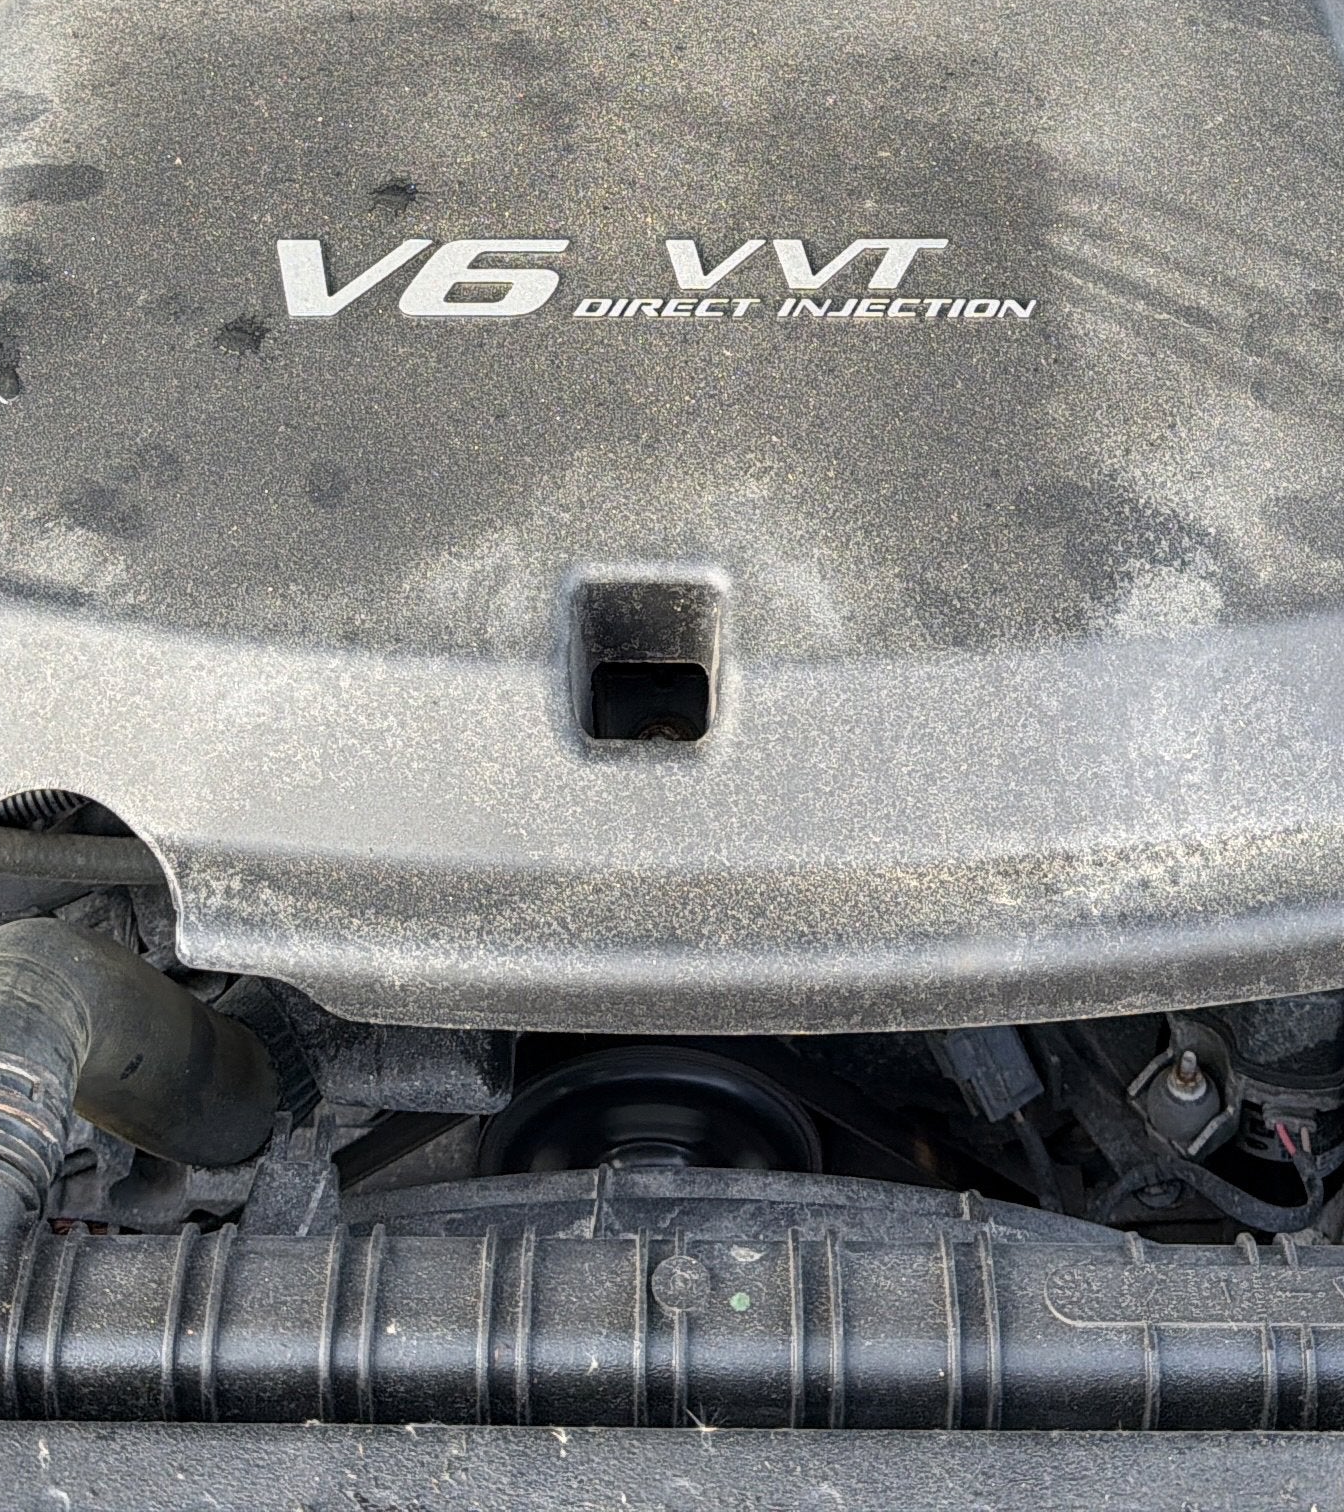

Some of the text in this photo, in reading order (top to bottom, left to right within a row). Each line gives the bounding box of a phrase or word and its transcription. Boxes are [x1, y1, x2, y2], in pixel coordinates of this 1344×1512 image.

[276, 238, 949, 317] V6 VVT
[572, 297, 1039, 319] DIRECT INJECTION
